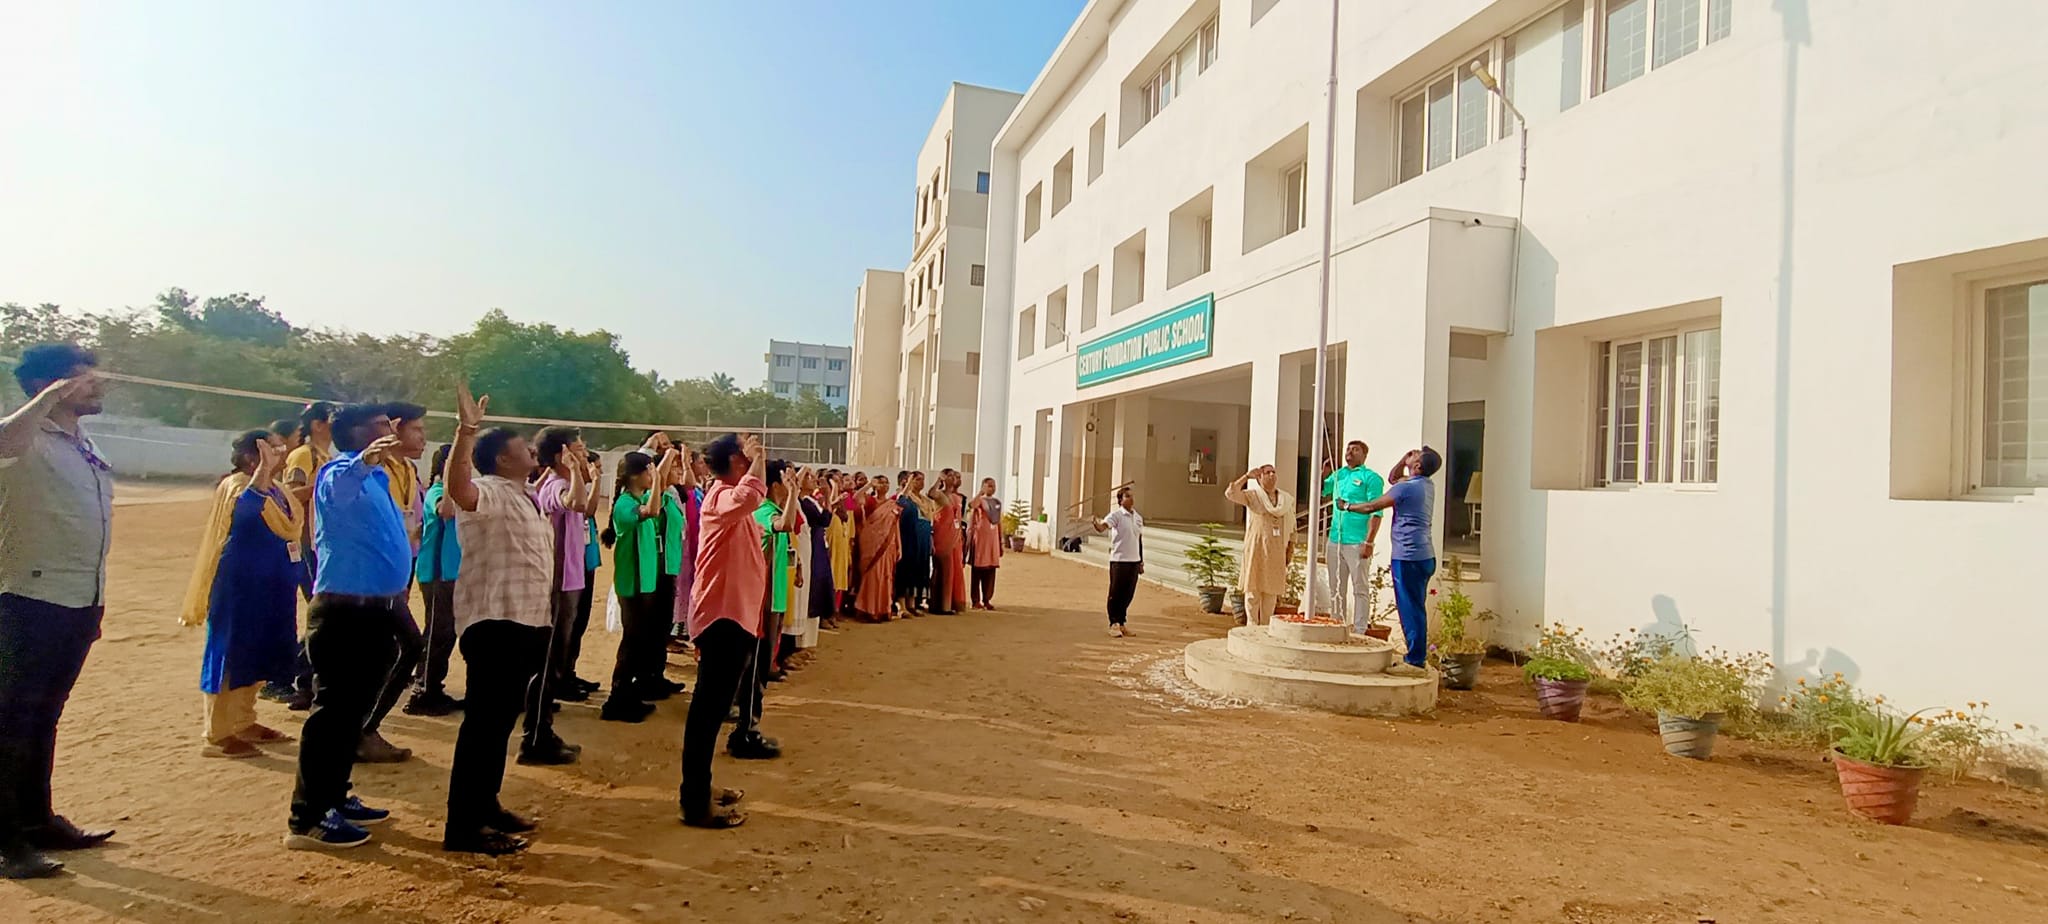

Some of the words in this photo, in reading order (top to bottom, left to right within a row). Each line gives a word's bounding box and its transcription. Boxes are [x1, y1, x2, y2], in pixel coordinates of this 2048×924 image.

[1080, 351, 1103, 376] CENTURY
[1104, 336, 1143, 368] FOUNDATION
[1144, 325, 1170, 357] PUBLIC
[1172, 313, 1204, 348] SCHOOL
